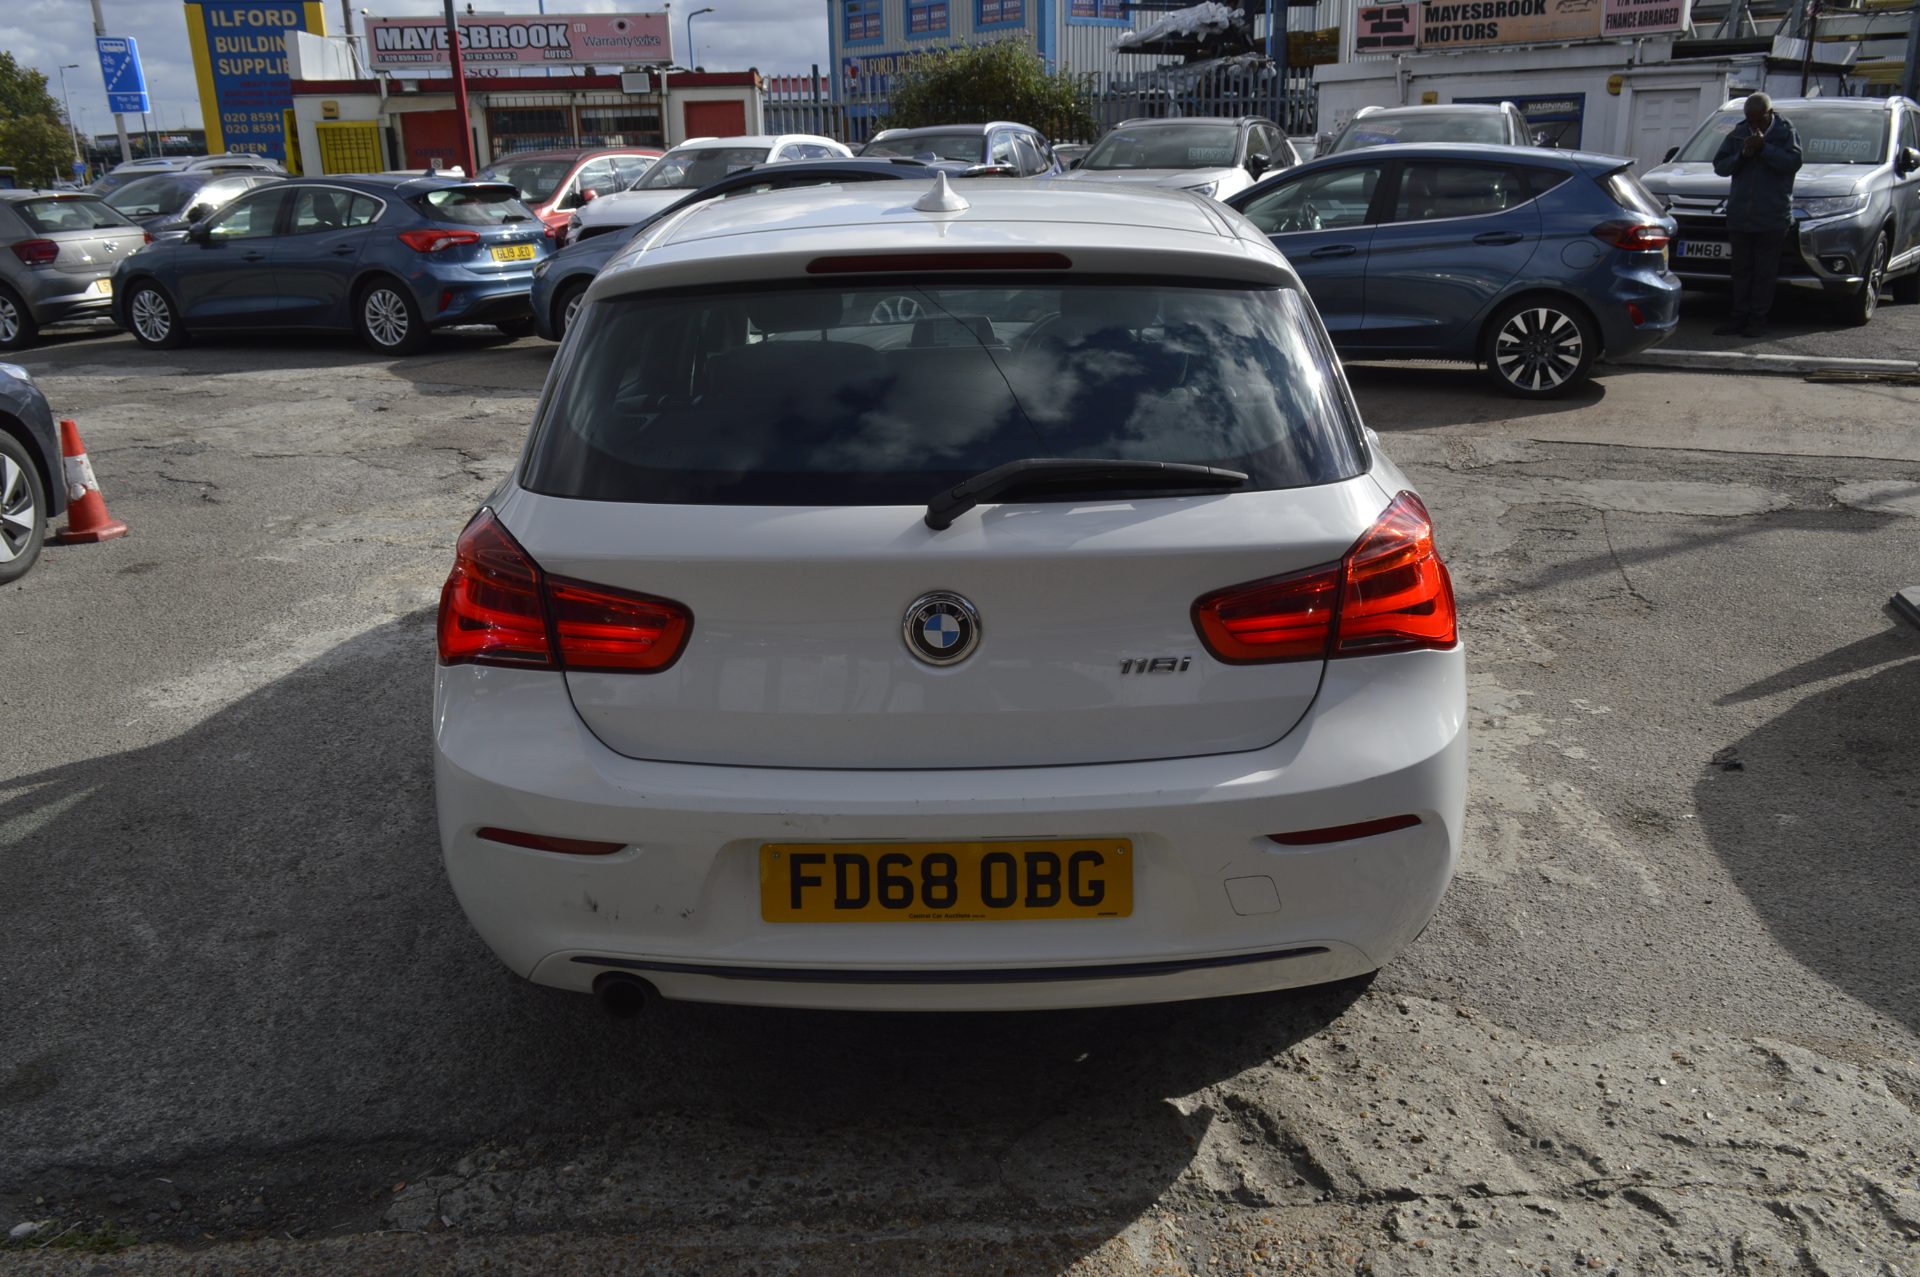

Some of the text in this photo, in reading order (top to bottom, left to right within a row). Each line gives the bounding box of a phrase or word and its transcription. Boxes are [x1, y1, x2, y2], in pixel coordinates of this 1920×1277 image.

[210, 9, 297, 27] ILFORD
[1424, 0, 1546, 23] MAYESBROOK
[1605, 11, 1638, 29] FINANCE
[1637, 8, 1680, 27] ARRANGED
[374, 23, 587, 51] MAYESBROOK LTD
[1424, 22, 1499, 43] MOTORS
[215, 35, 288, 53] BUILDIN
[543, 49, 572, 59] AUTOS
[218, 58, 290, 75] SUPPLIE
[860, 56, 894, 77] ILFORD
[223, 112, 280, 123] 020 8591
[226, 123, 281, 134] 020 8591
[230, 143, 267, 153] OPEN
[1686, 243, 1722, 256] MM68
[917, 603, 967, 622] BMW
[1119, 656, 1192, 674] 118i
[789, 850, 1106, 909] FD68 OBG
